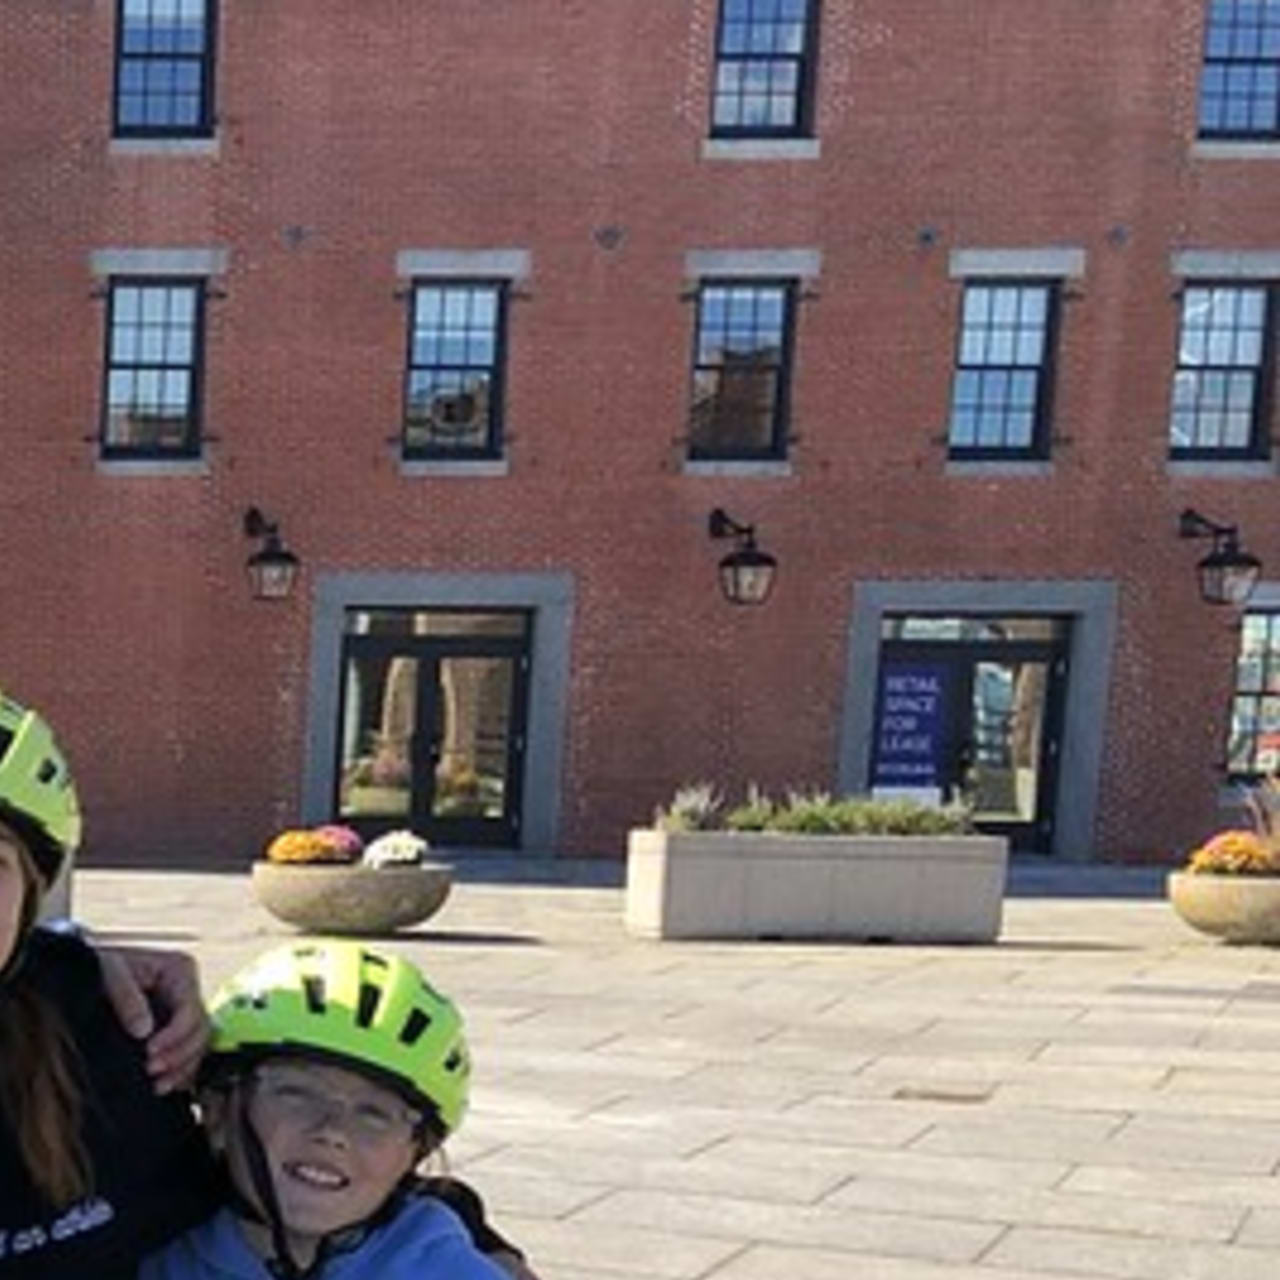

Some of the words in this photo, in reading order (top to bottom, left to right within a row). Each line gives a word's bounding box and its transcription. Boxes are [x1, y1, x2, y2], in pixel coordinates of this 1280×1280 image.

[885, 676, 941, 693] RETAIL
[884, 696, 936, 713] SPACE
[882, 716, 918, 732] FOR
[880, 735, 932, 752] LEASE
